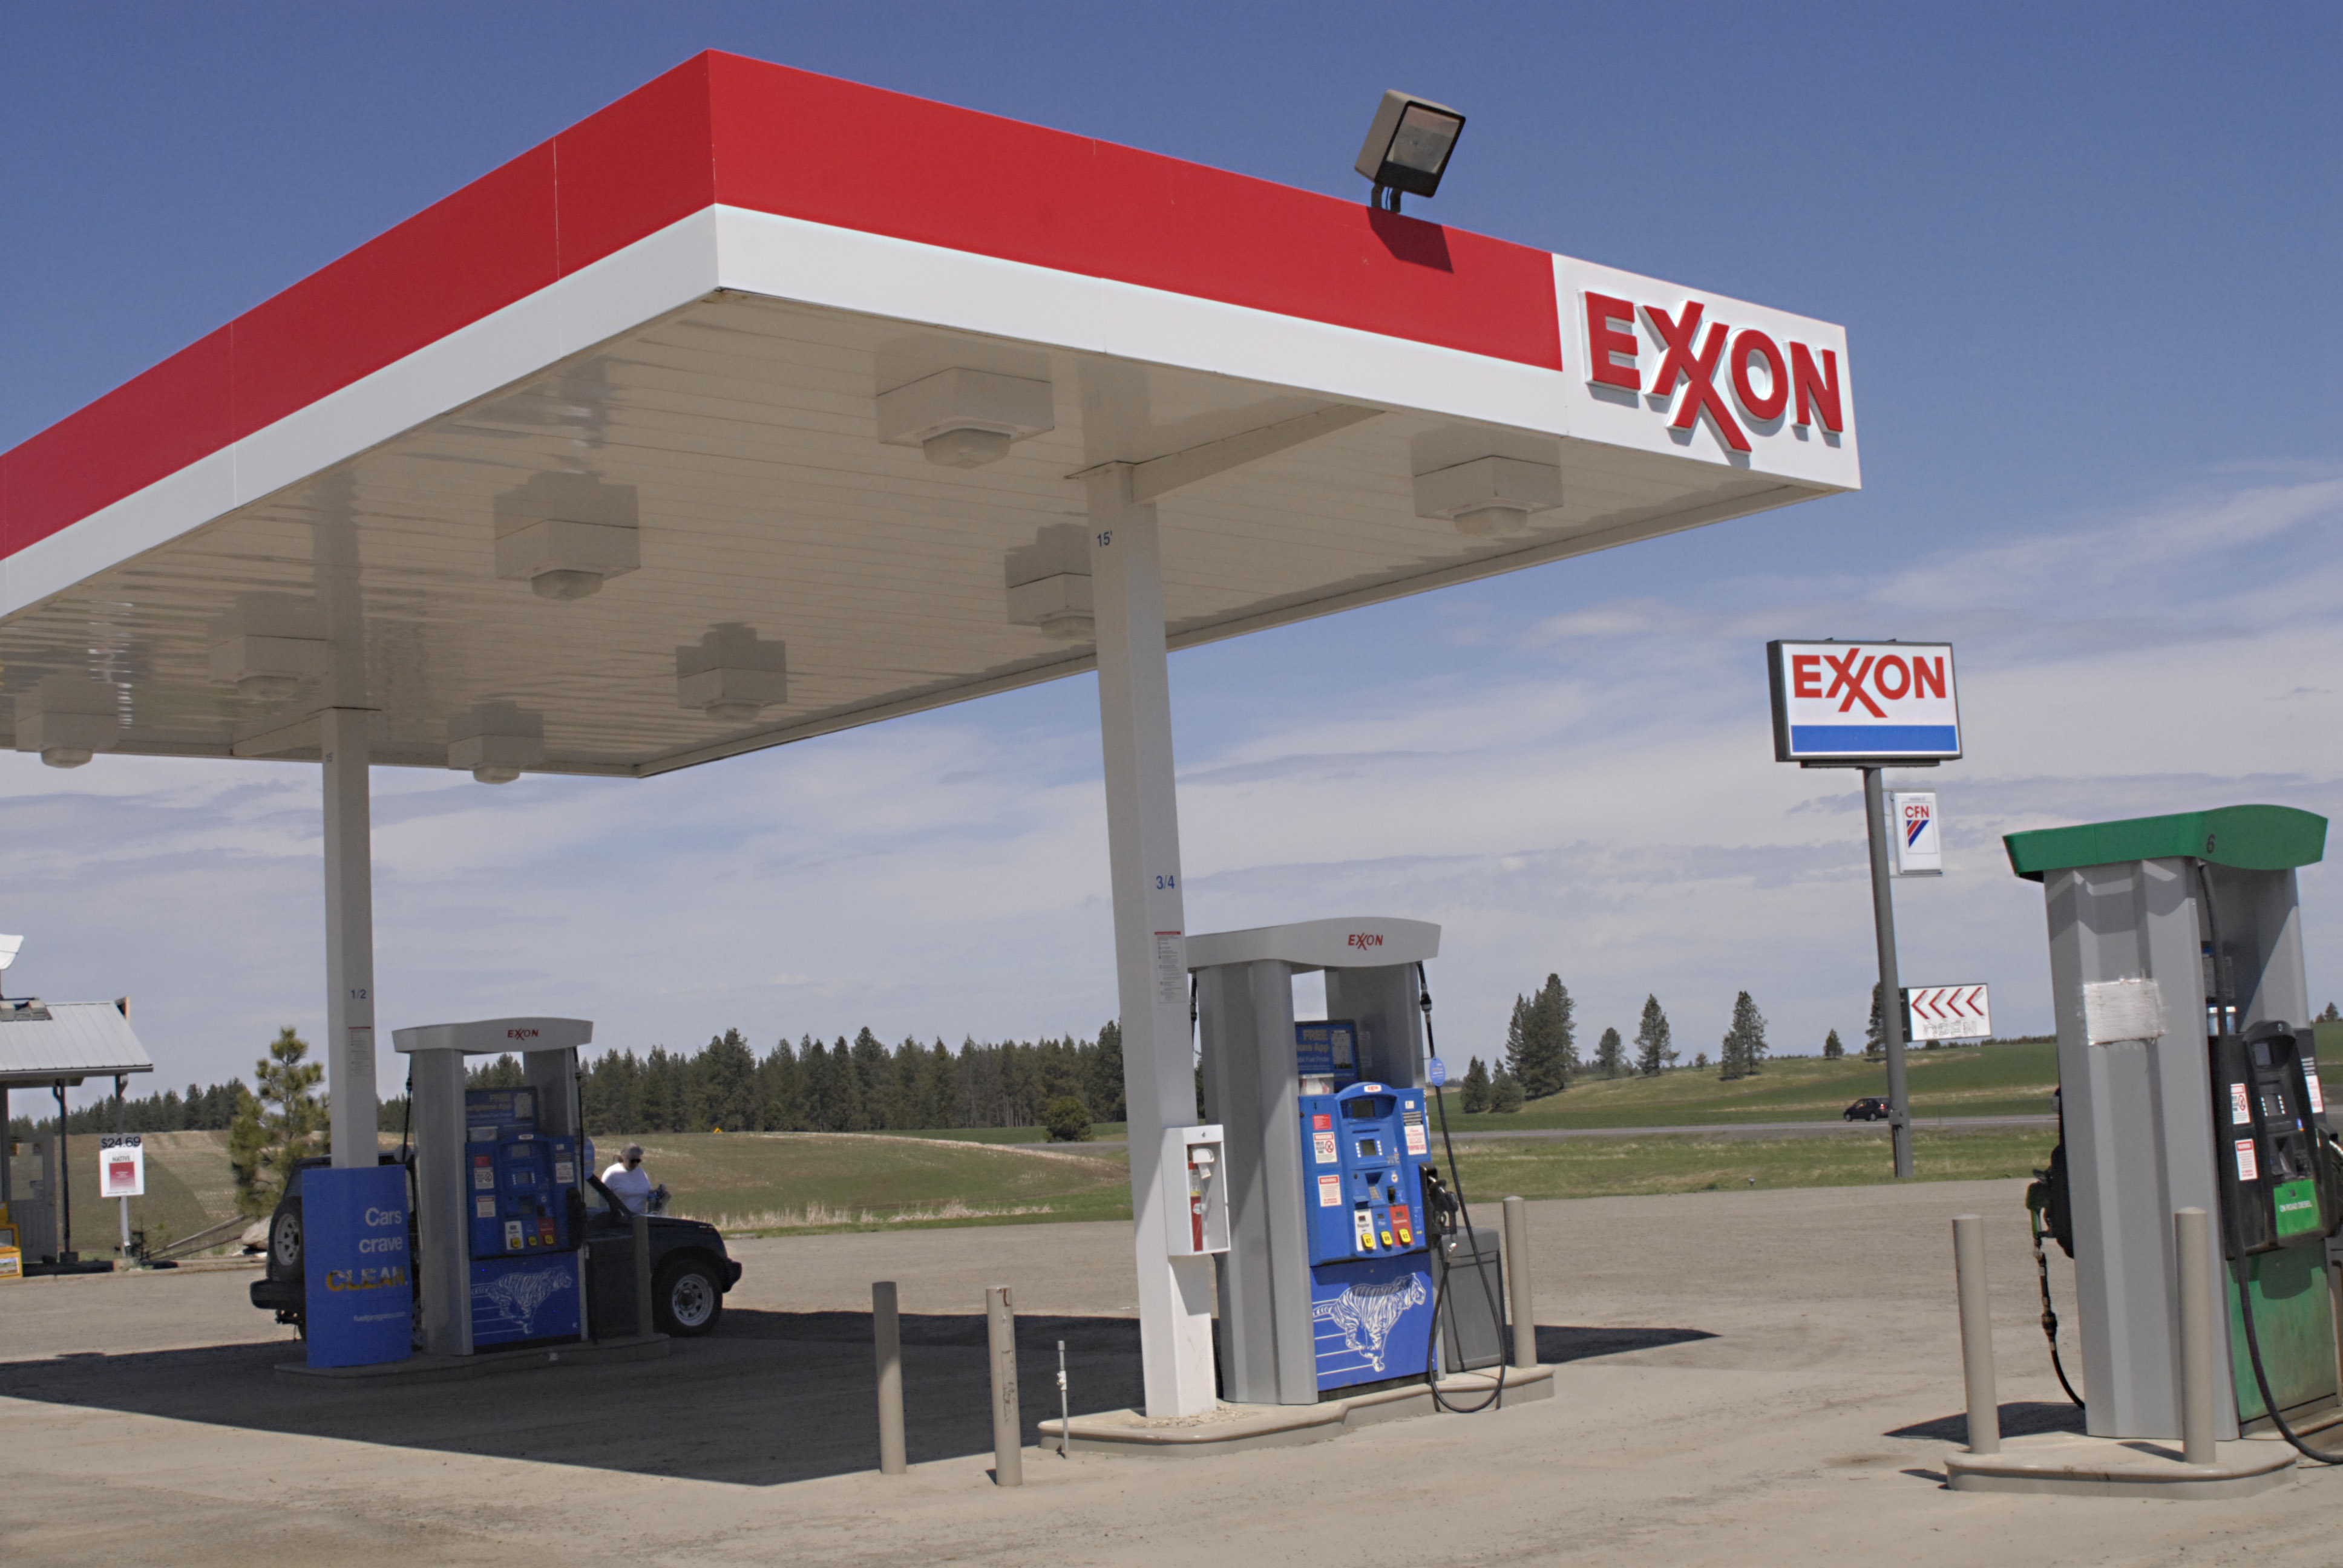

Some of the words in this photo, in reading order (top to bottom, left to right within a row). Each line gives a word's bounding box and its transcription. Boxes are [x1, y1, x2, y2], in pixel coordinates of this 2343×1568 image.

[1578, 290, 1843, 454] EXXON
[1097, 530, 1112, 547] 15'
[1792, 648, 1946, 718] EXXON
[1905, 805, 1929, 818] CFN
[2206, 834, 2215, 854] 6
[1156, 875, 1175, 890] 3/4
[1348, 932, 1383, 951] EXXON
[350, 989, 367, 999] 1/2
[507, 1028, 539, 1041] EXXON
[1303, 1029, 1328, 1041] FREE
[1922, 1020, 1977, 1039] OPEN
[101, 1137, 142, 1149] $24.69
[365, 1207, 402, 1227] Cars
[359, 1236, 402, 1253] crave
